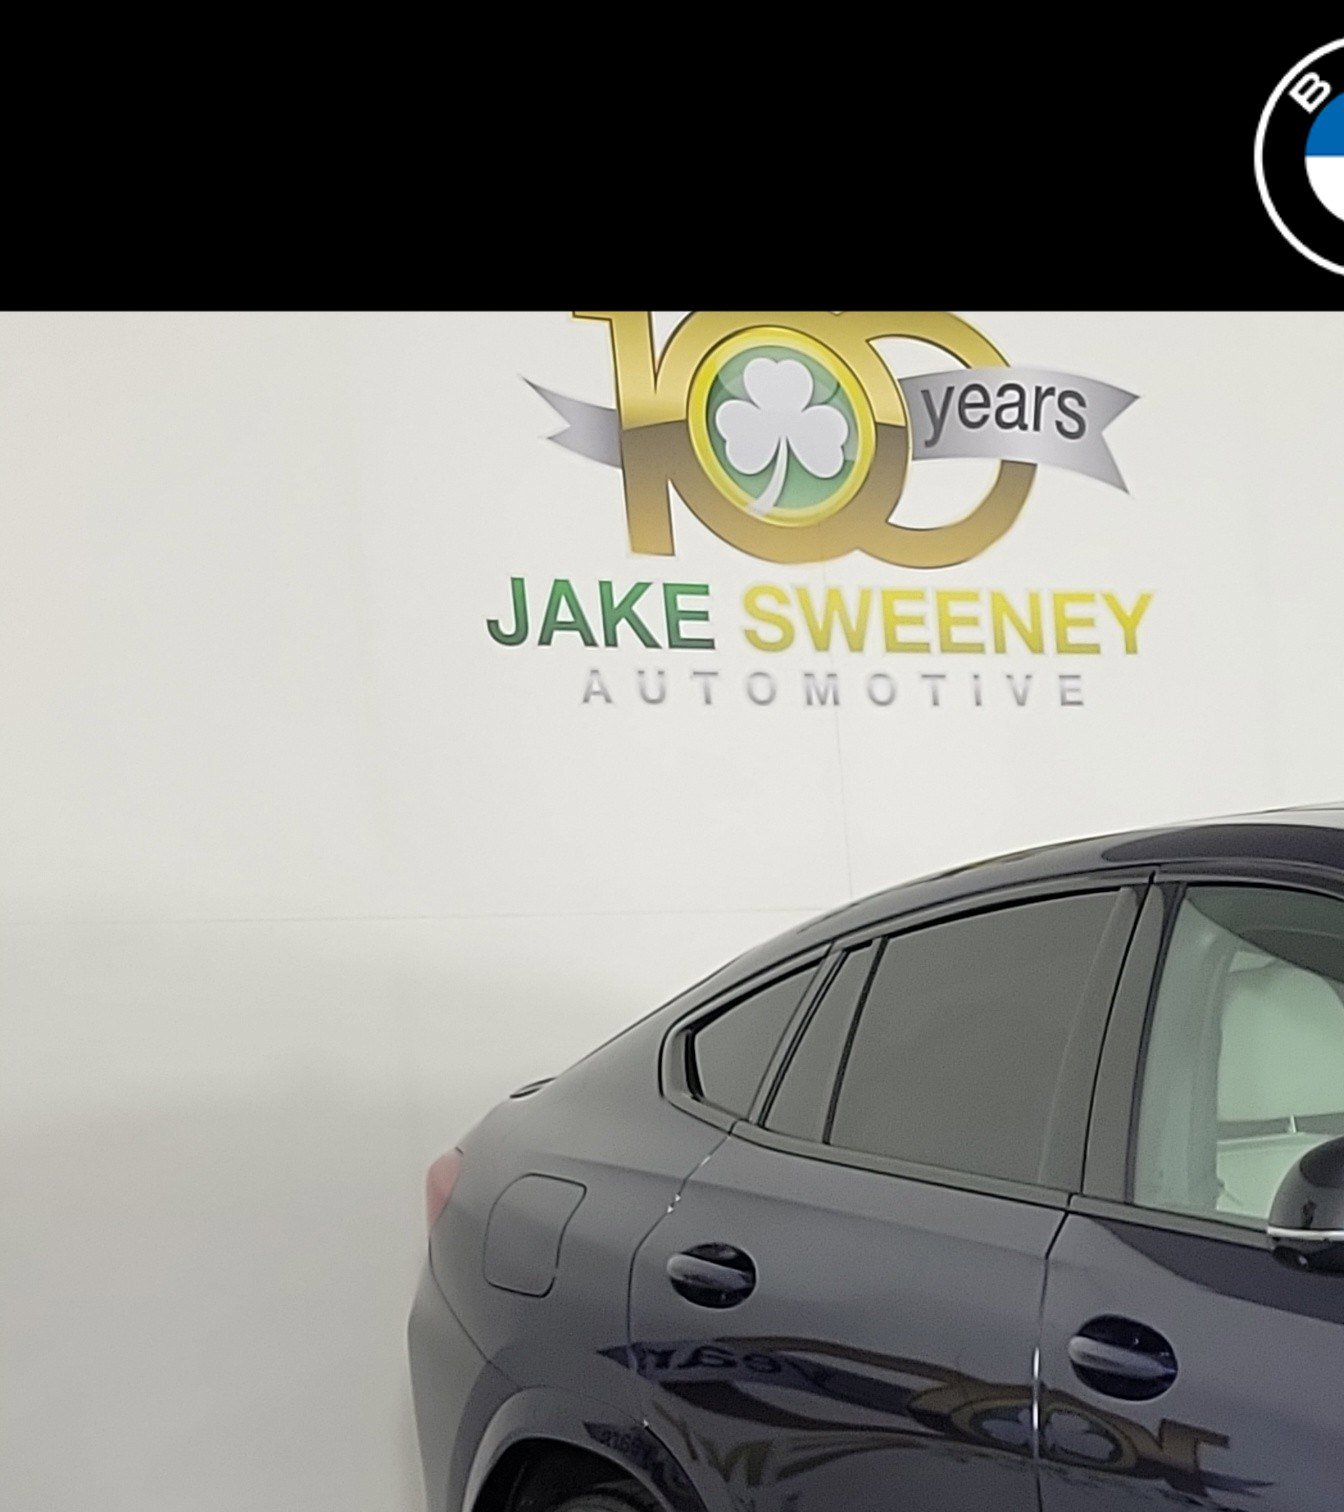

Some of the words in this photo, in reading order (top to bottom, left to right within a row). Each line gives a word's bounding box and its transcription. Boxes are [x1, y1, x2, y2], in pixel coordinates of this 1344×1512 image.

[921, 381, 1086, 447] years
[486, 577, 715, 650] JAKE
[743, 584, 1152, 655] SWEENEY
[582, 669, 1084, 707] AUTOMOTIVE
